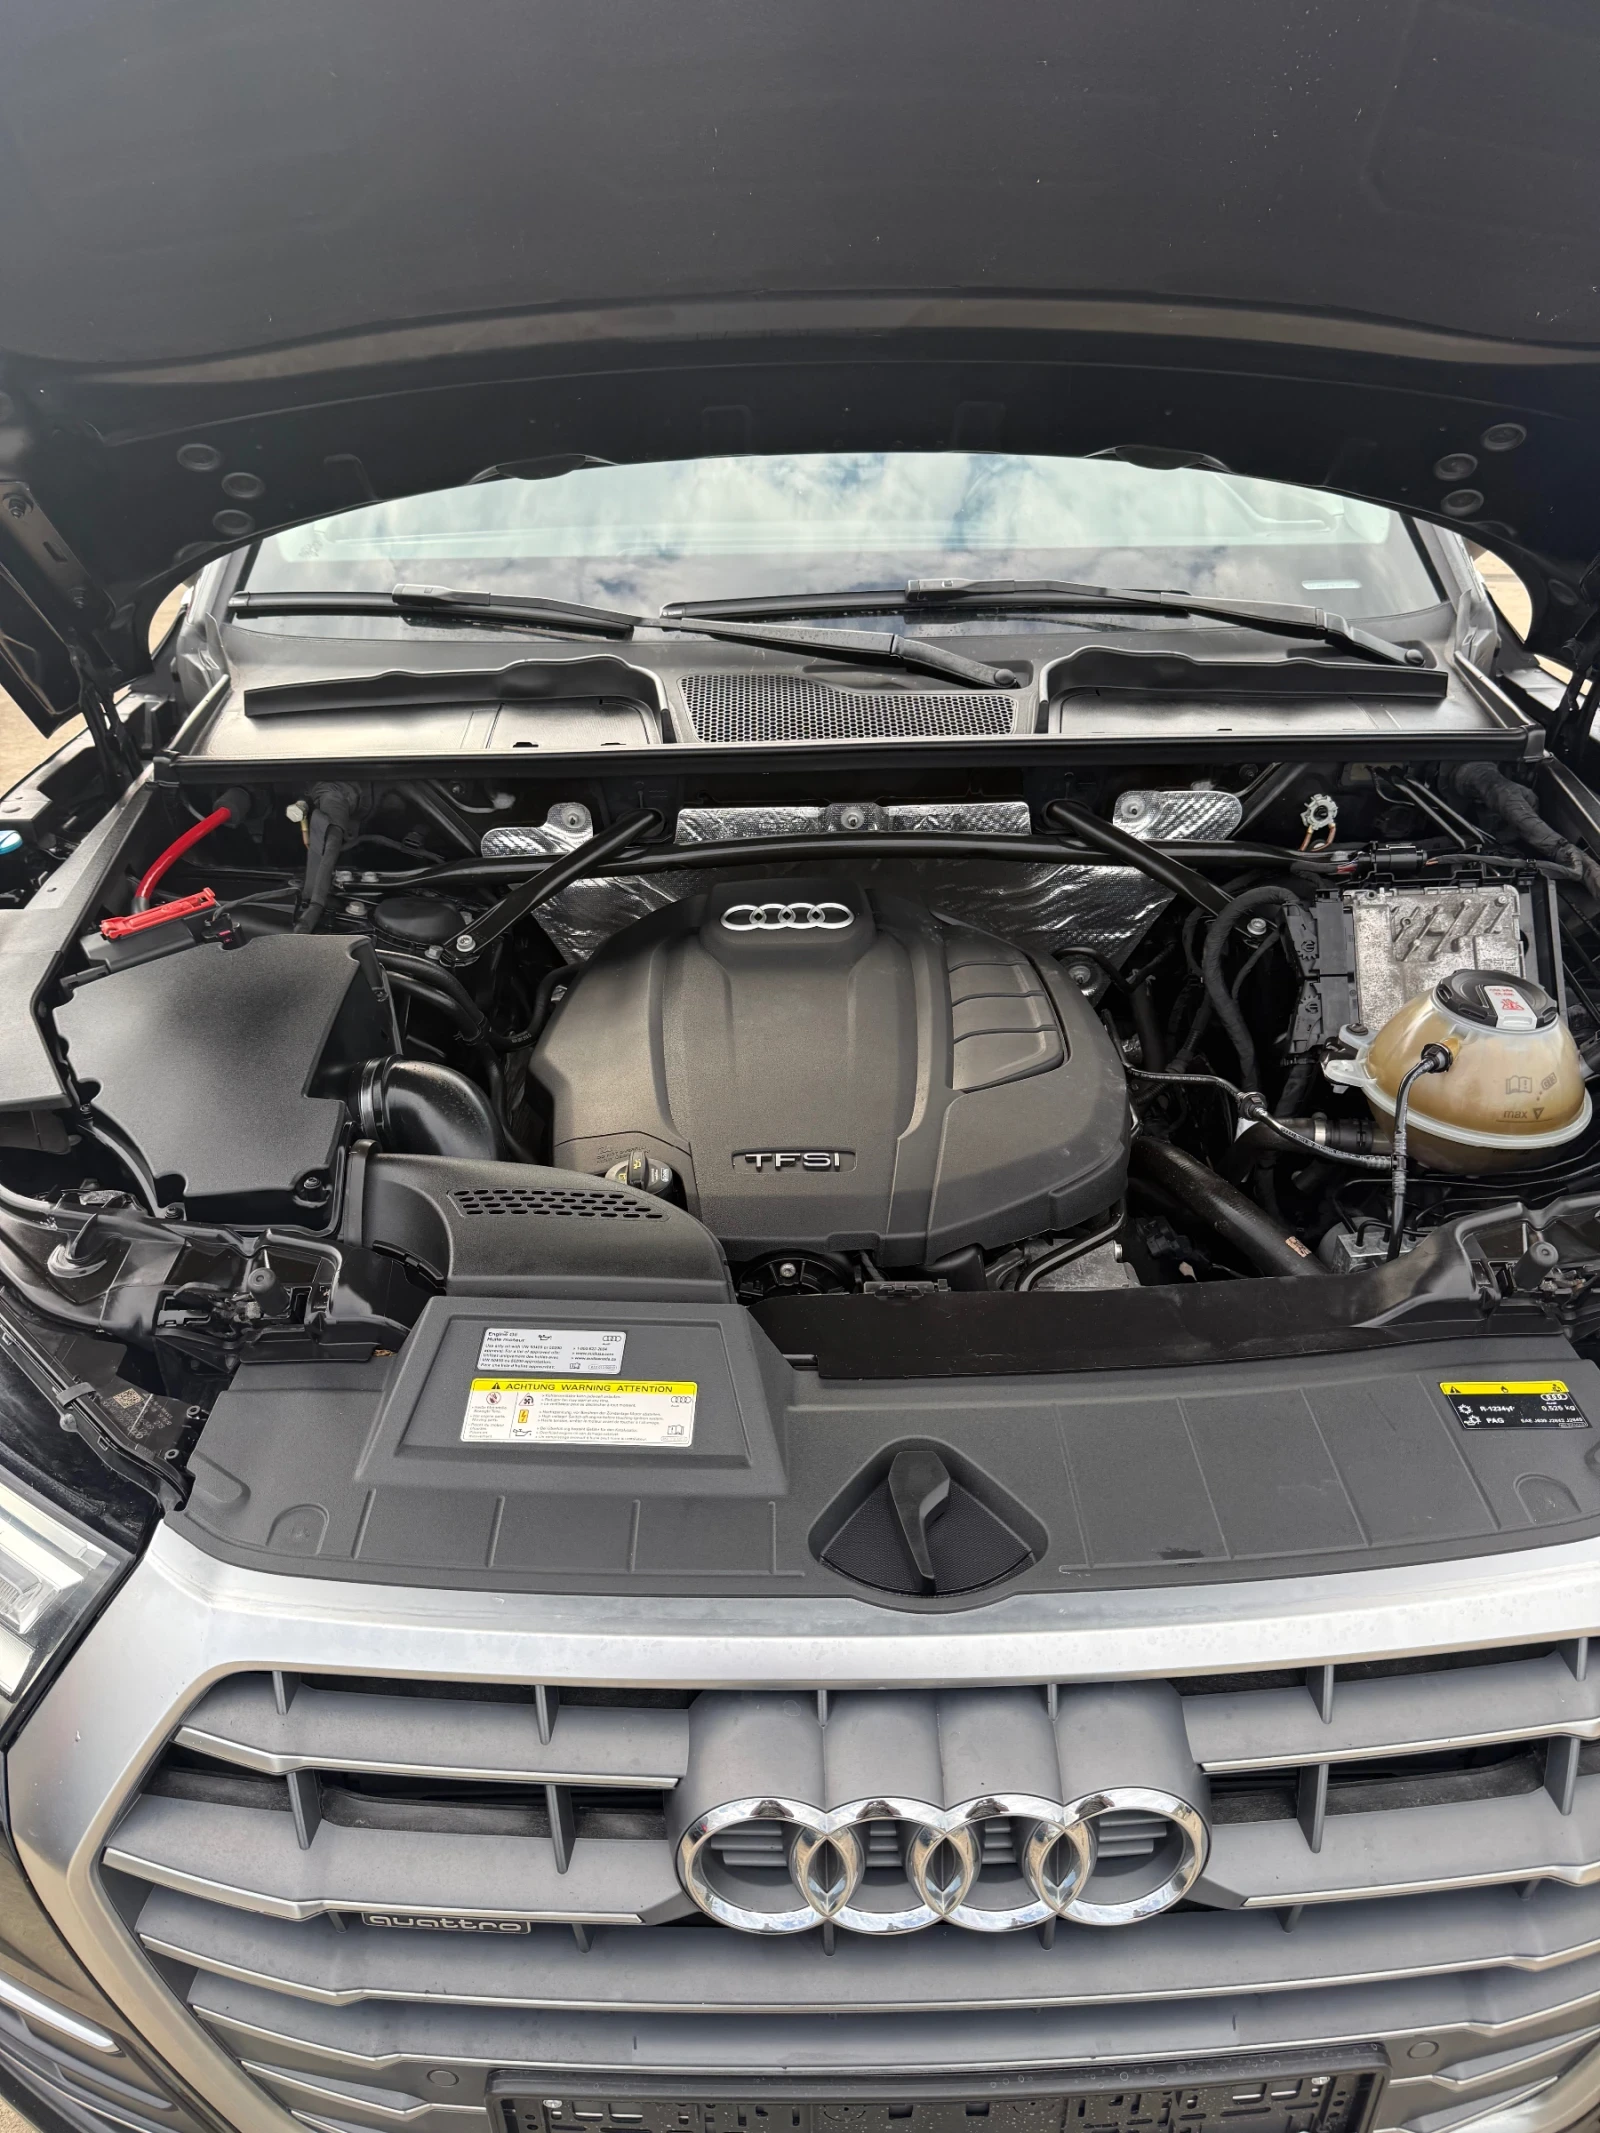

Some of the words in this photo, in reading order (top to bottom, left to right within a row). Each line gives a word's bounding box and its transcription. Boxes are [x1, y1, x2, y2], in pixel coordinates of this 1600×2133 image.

[1503, 1110, 1529, 1119] max
[745, 1152, 841, 1170] TFSI
[505, 1383, 555, 1391] ACHTUNG
[561, 1384, 611, 1392] WARNING
[616, 1385, 673, 1393] ATTENTION
[369, 1916, 522, 1930] quattro
